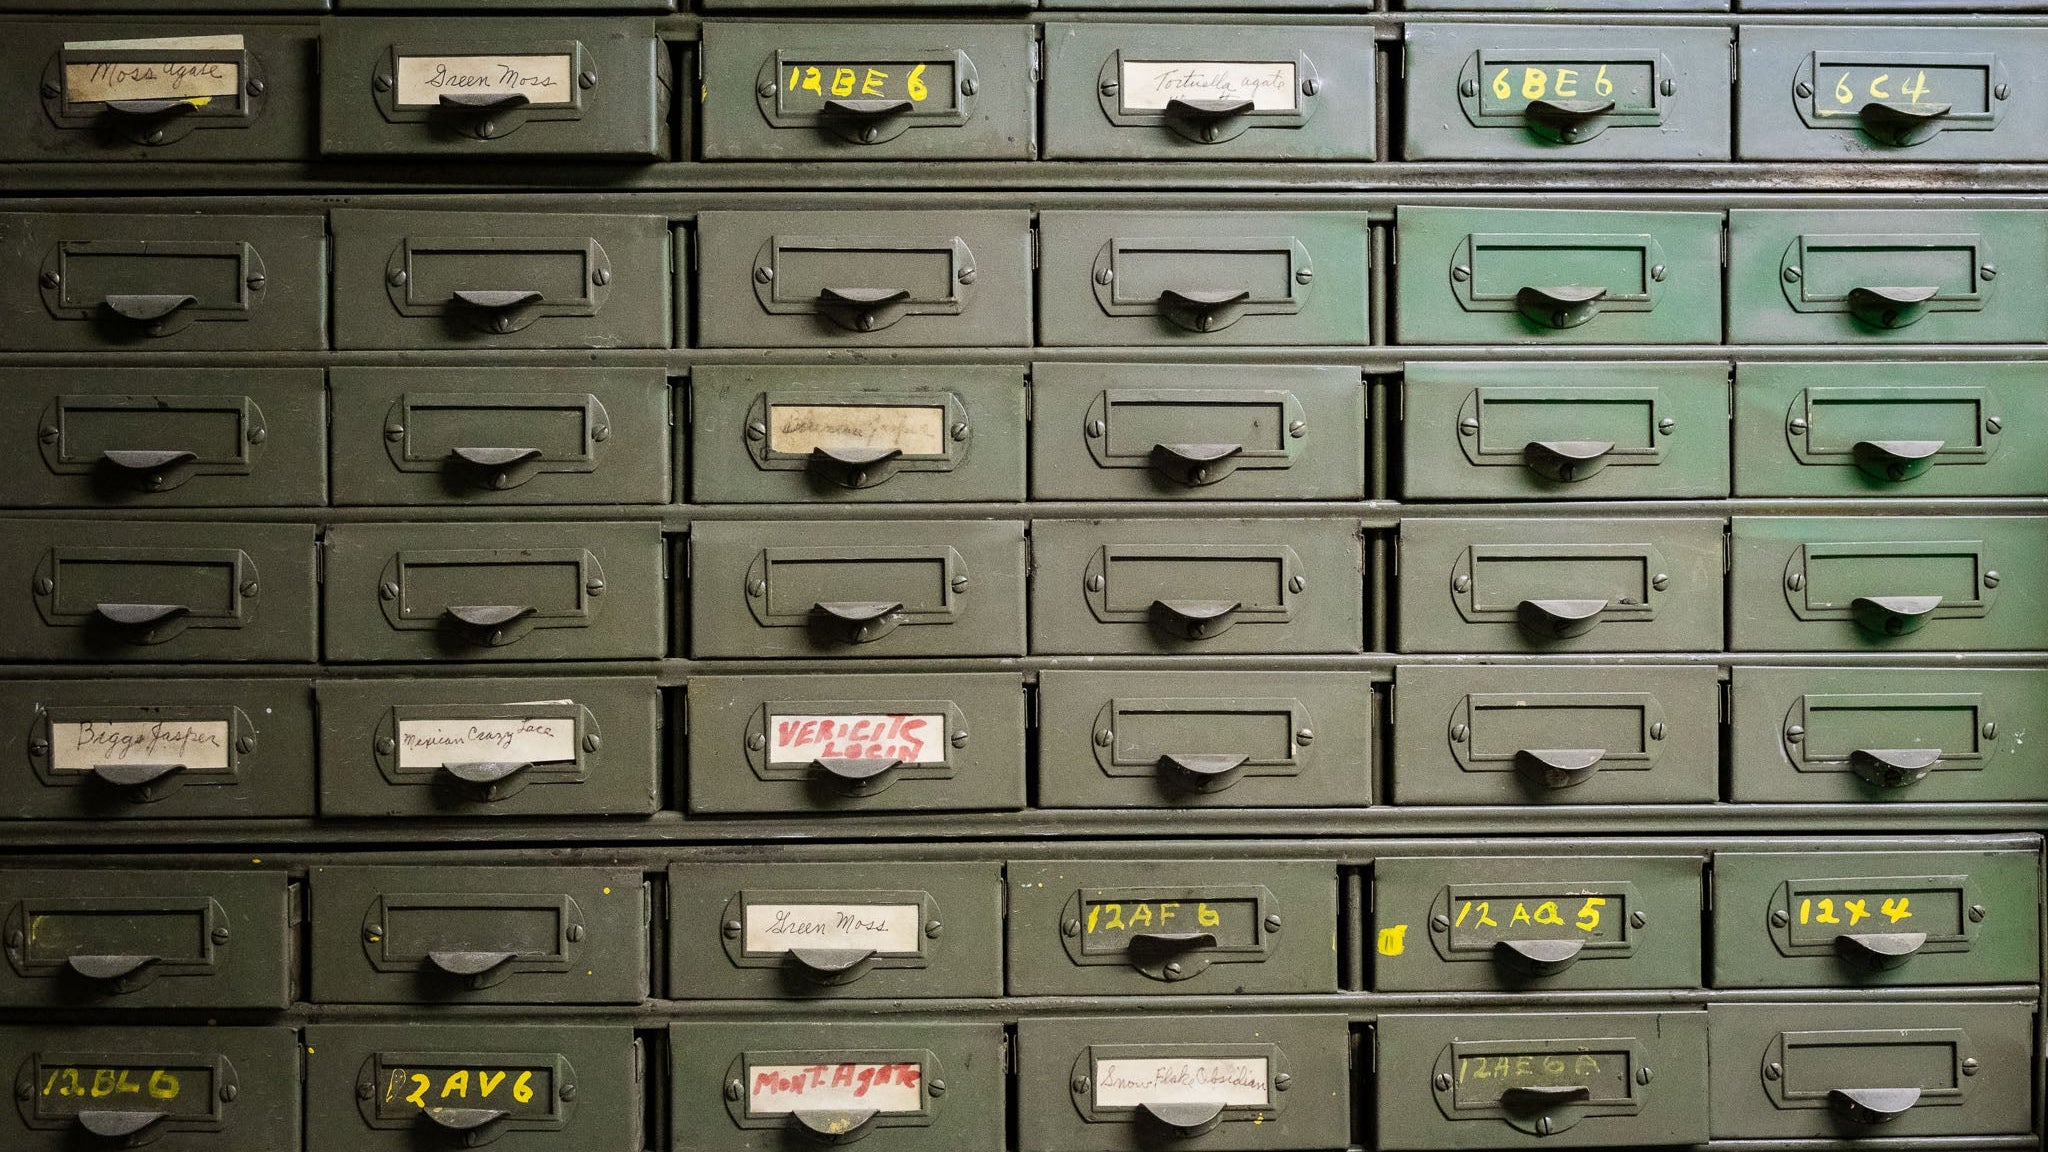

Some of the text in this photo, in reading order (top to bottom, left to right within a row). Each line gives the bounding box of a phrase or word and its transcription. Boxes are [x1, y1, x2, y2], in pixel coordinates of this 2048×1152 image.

[425, 64, 556, 88] Green Moss
[906, 63, 928, 101] 6
[1595, 65, 1613, 97] 6
[404, 717, 555, 750] Mexican Crazy Lace
[765, 910, 889, 935] Green Moss
[1198, 902, 1220, 928] 6
[1575, 897, 1606, 931] 5
[149, 1070, 179, 1098] 6
[1196, 1066, 1267, 1091] Obsidian
